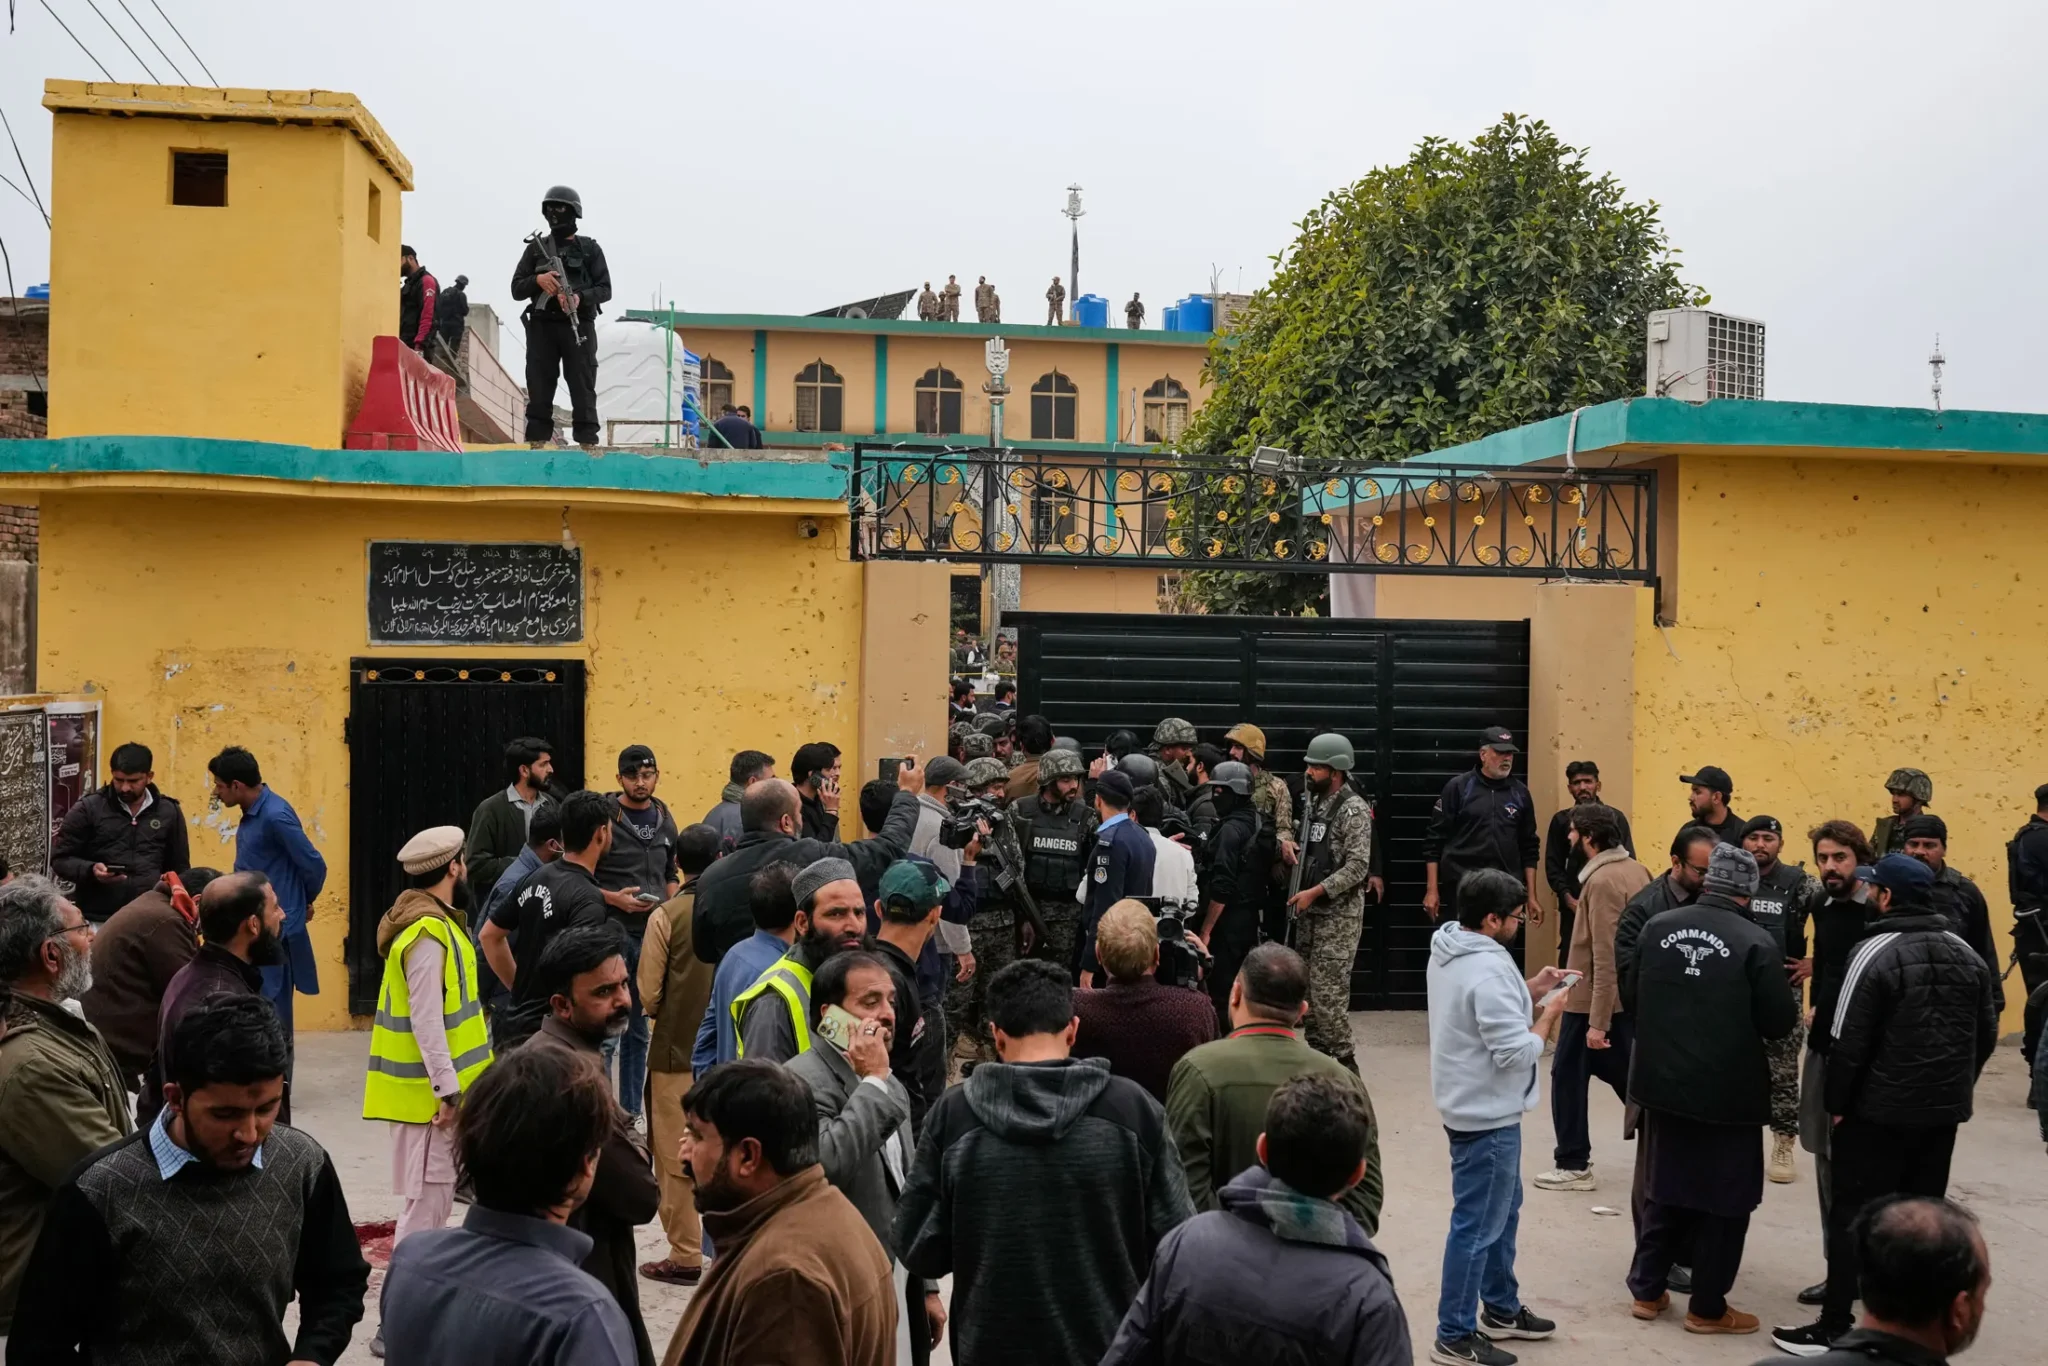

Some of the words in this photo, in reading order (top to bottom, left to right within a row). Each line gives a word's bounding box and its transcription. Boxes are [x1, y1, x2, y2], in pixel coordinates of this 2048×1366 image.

[418, 558, 462, 587] کونسل
[454, 559, 477, 588] ضلع
[473, 567, 501, 590] جعفریہ
[558, 563, 576, 587] دفتر
[525, 617, 549, 638] جامع
[549, 615, 577, 637] مرکزی
[1033, 836, 1078, 852] RANGERS
[1751, 899, 1784, 915] GERS
[1660, 928, 1731, 959] COMMANDO
[1684, 966, 1701, 977] ATS
